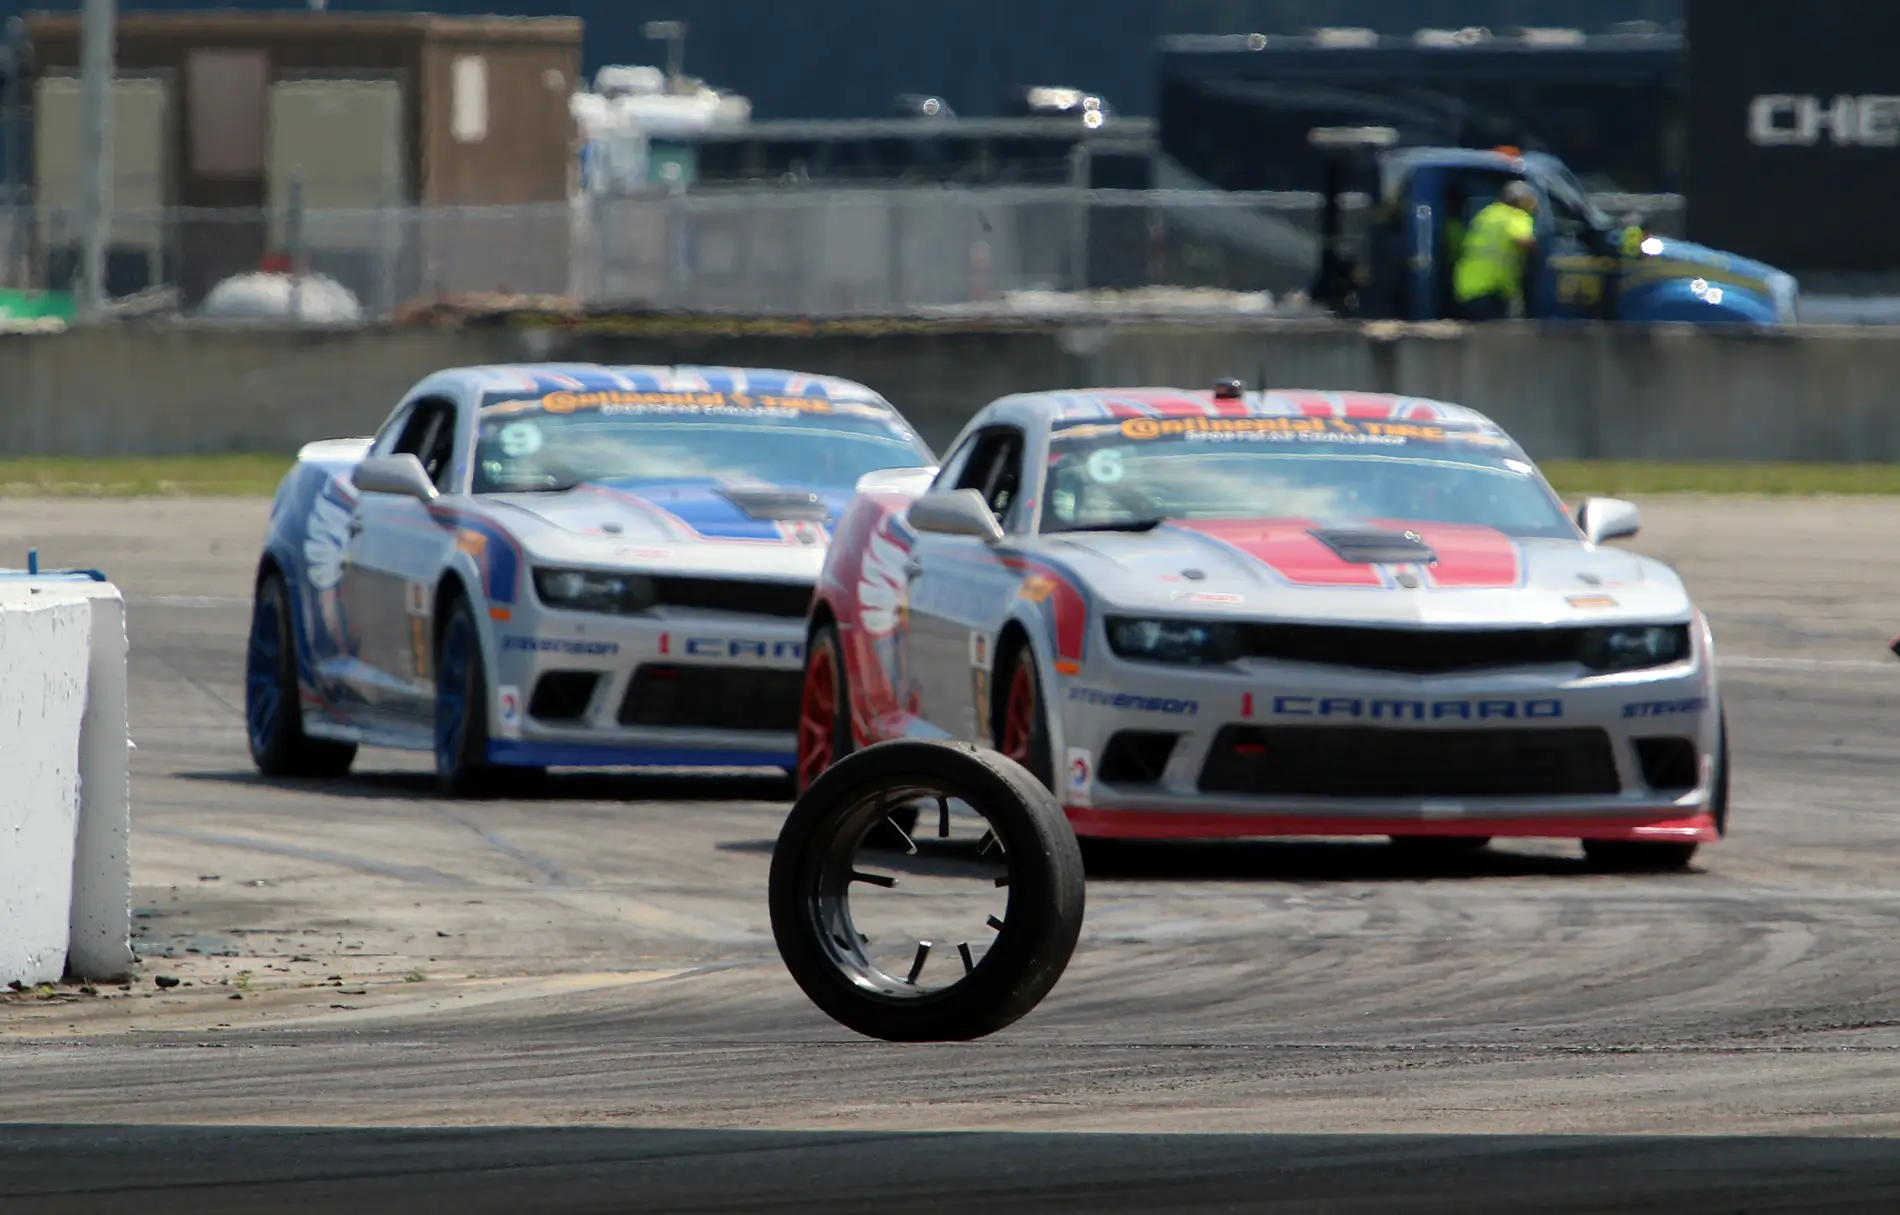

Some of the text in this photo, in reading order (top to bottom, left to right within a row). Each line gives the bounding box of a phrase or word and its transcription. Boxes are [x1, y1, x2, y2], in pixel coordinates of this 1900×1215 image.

[500, 423, 542, 457] 9
[1087, 448, 1124, 483] 6
[1273, 696, 1563, 719] CAMARO
